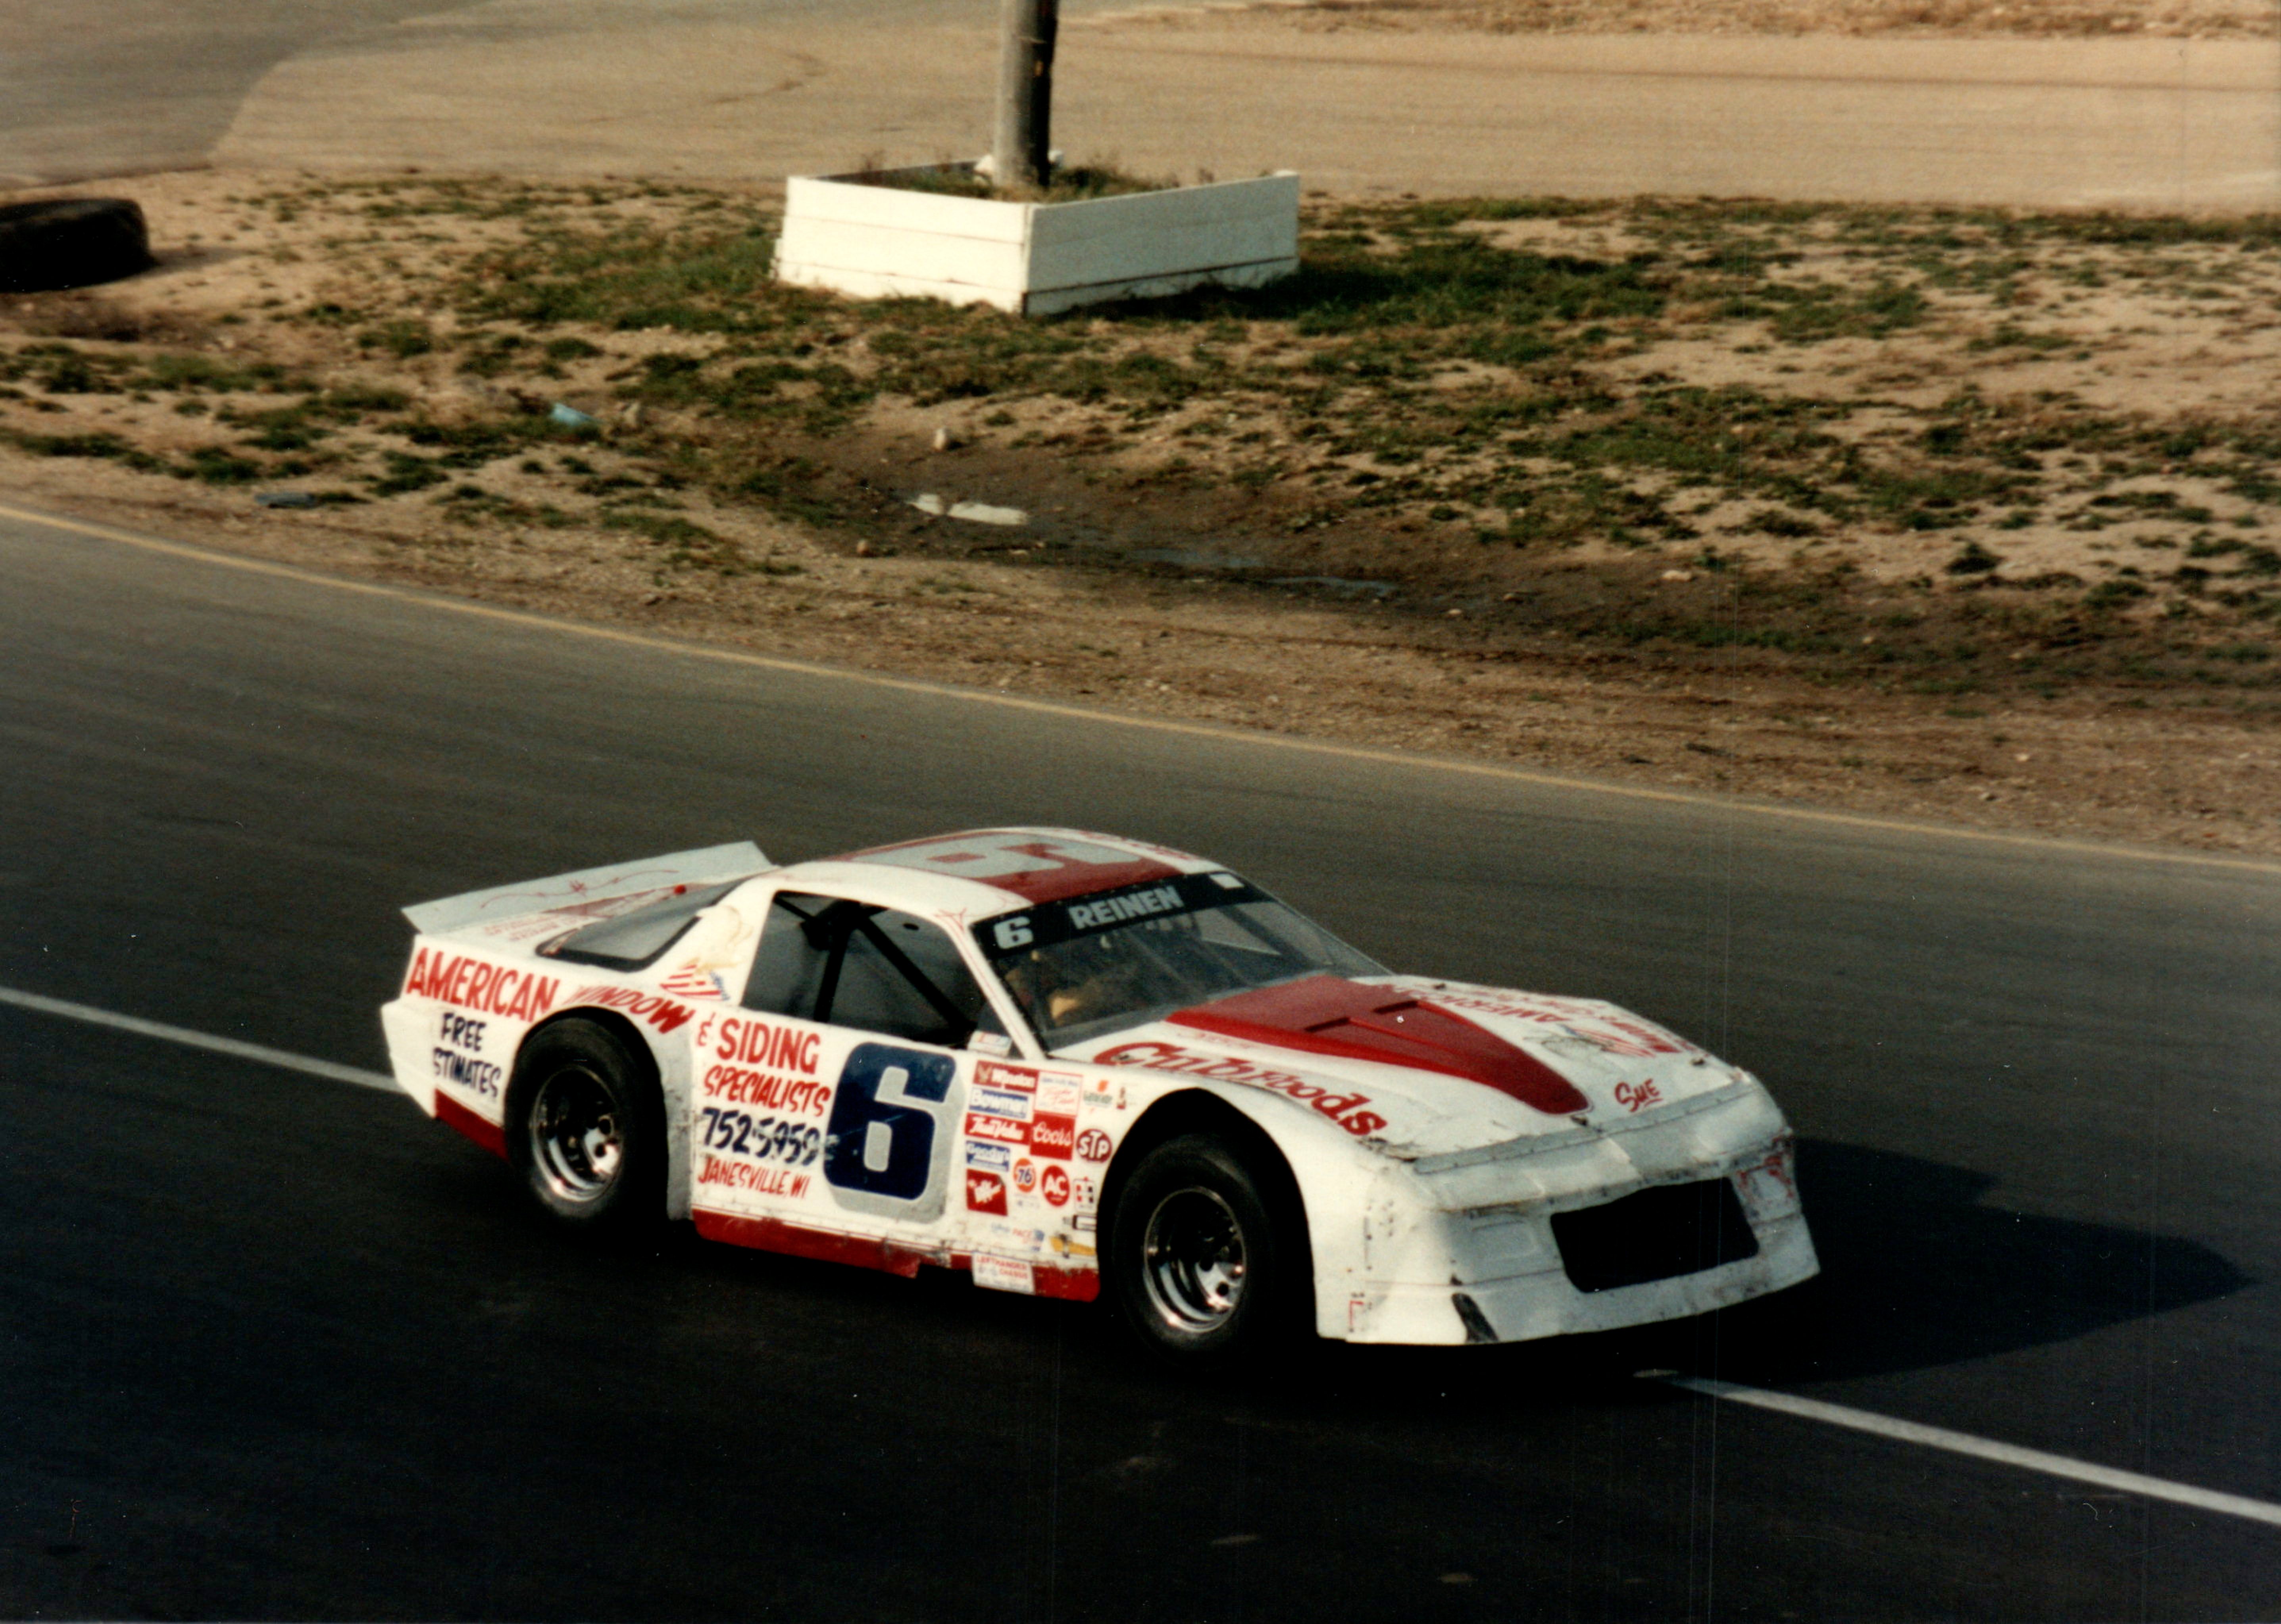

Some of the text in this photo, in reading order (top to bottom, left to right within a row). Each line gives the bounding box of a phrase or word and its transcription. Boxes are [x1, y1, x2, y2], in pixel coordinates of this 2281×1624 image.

[993, 886, 1185, 950] 6 REINEN
[406, 946, 560, 1023] AMERICAN
[561, 985, 697, 1034] WINDOW
[716, 1018, 821, 1074] SIDING
[440, 1012, 487, 1052] FREE
[703, 1064, 832, 1117] SPECIALISTS
[1092, 1041, 1387, 1137] Cub Foods
[823, 1041, 957, 1201] 6
[1033, 1121, 1073, 1147] Coors
[1078, 1131, 1110, 1159] STP
[790, 1173, 811, 1200] WI
[1018, 1168, 1033, 1184] 76
[1044, 1174, 1067, 1196] AC
